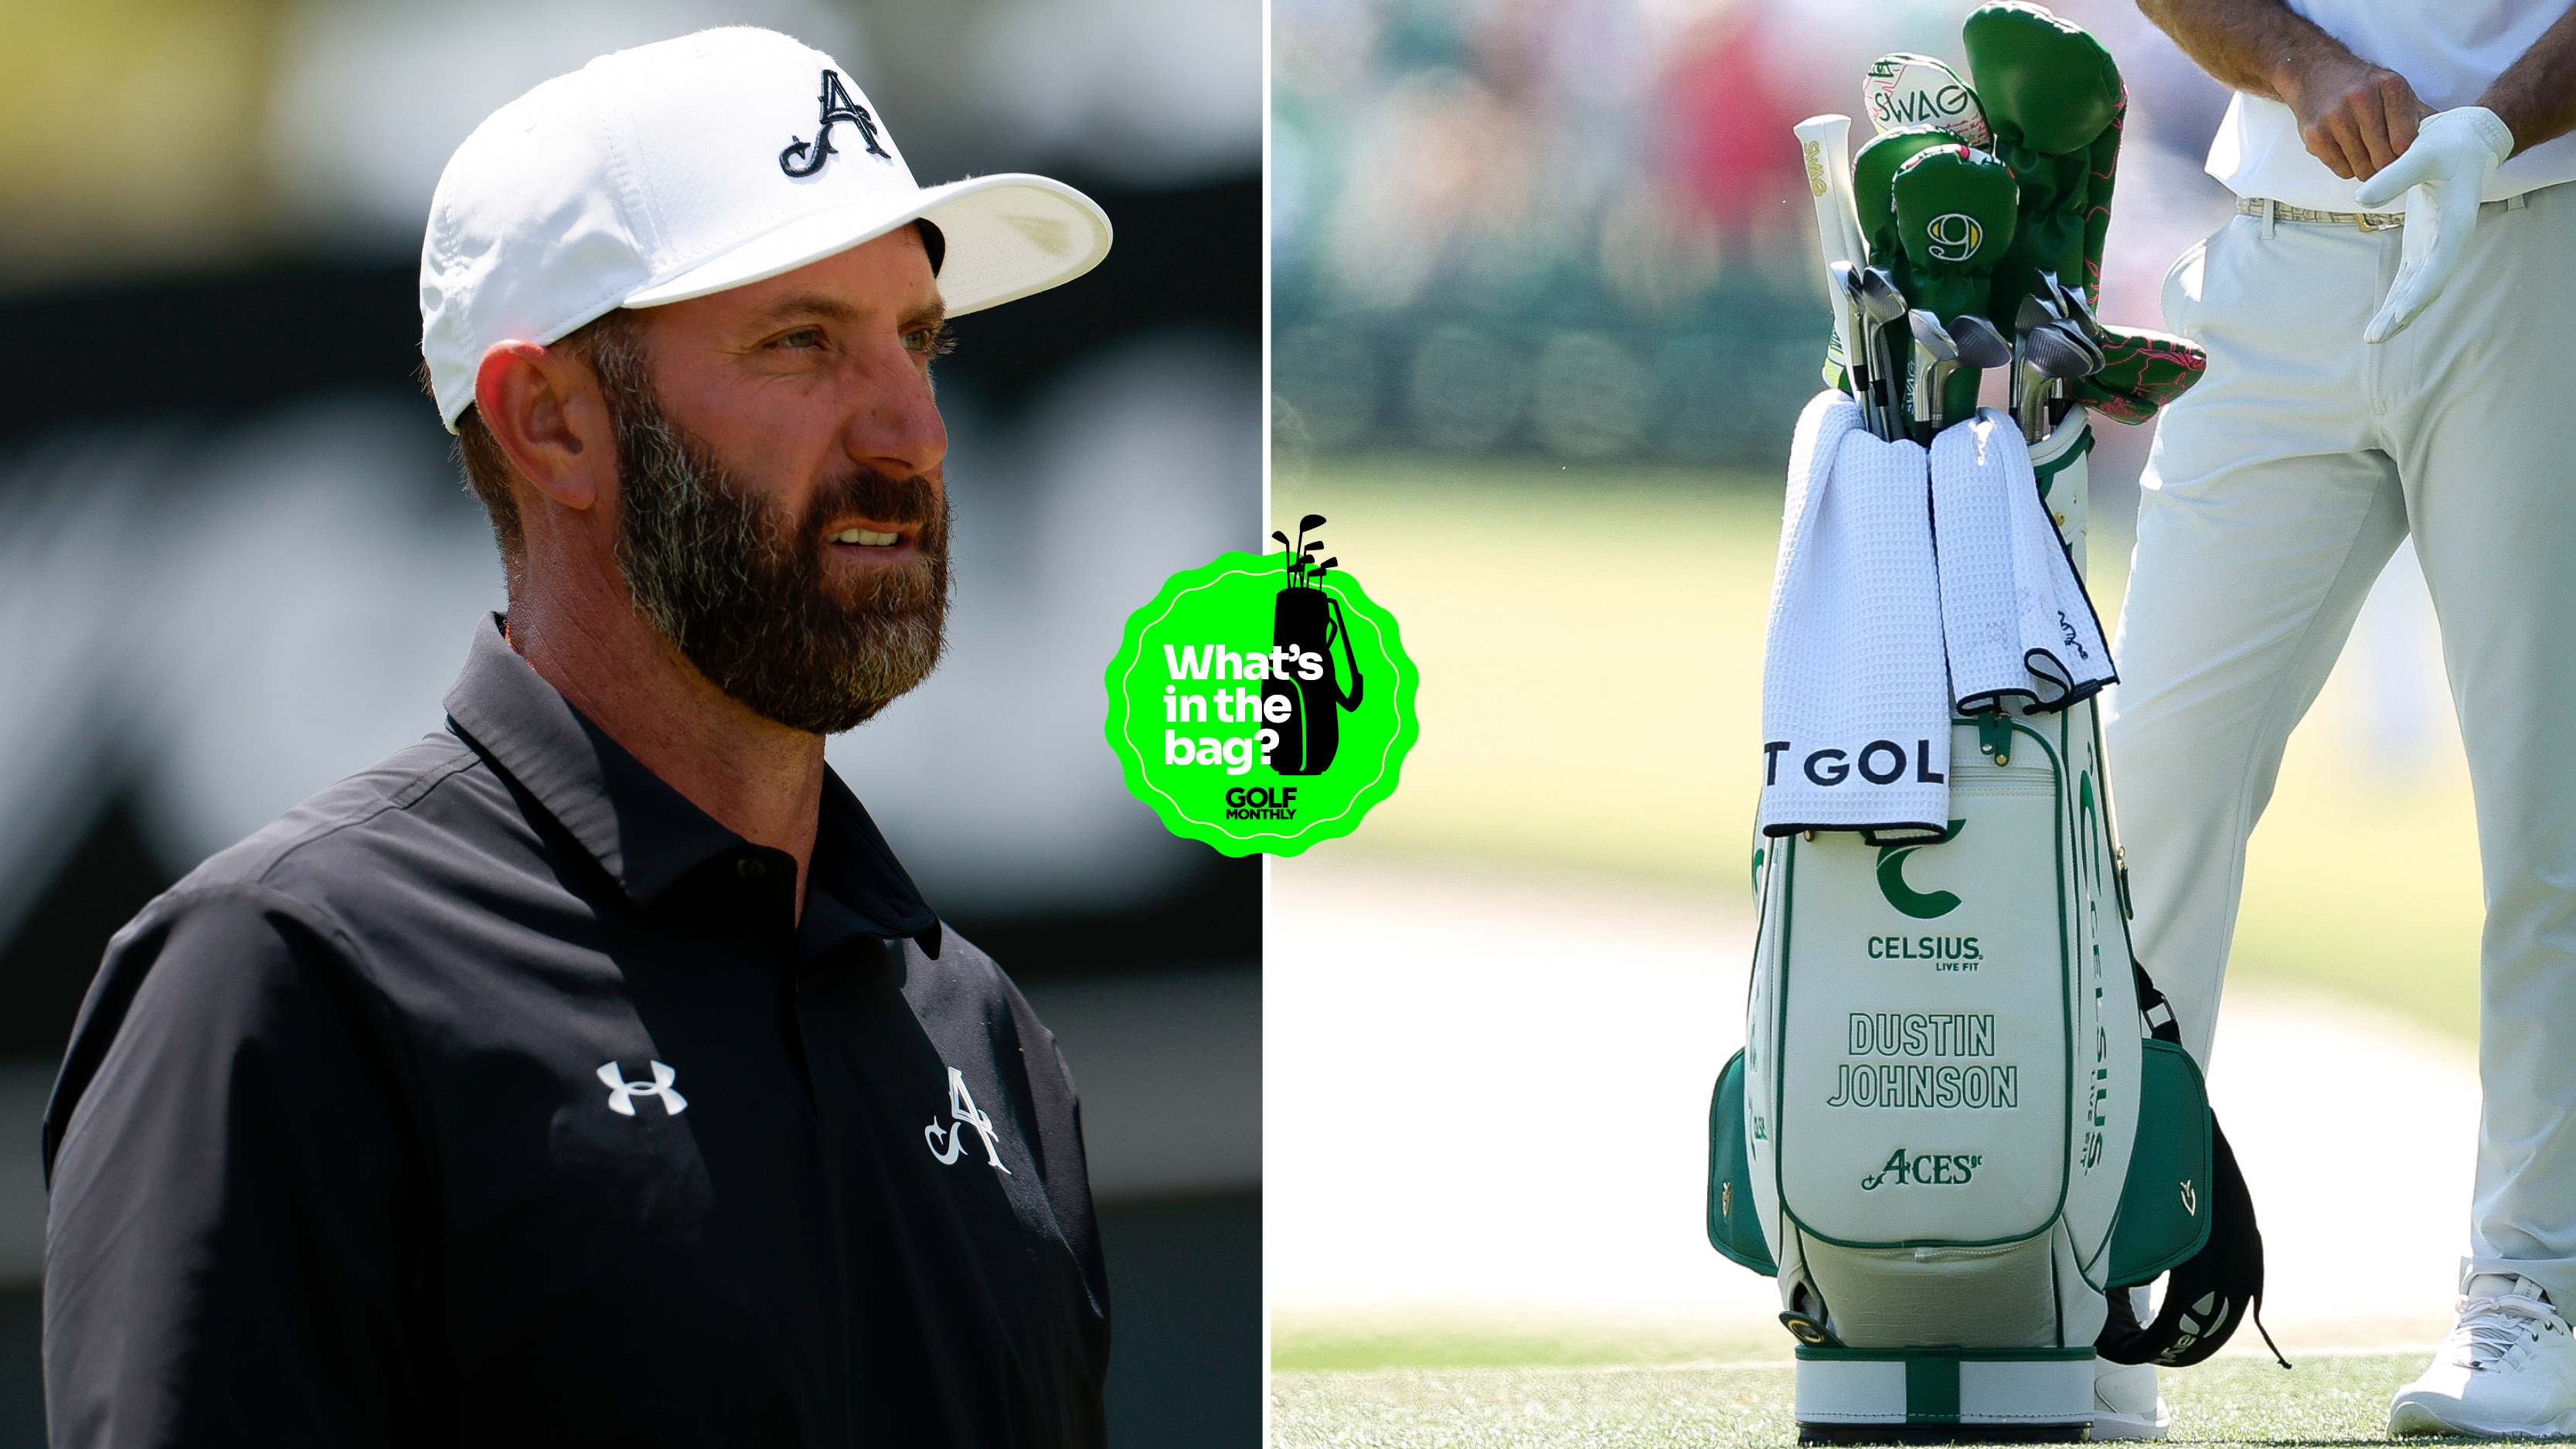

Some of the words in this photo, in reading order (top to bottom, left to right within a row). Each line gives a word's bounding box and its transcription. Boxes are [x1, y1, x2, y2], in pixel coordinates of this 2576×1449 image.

[1874, 85, 1969, 123] SWAG
[1804, 141, 1828, 197] SWAG
[1927, 213, 1983, 262] 9
[1936, 963, 1959, 971] LIVE
[1962, 963, 1979, 971] FIT
[1849, 1013, 1995, 1056] DUSTIN
[1826, 1064, 2018, 1108] JOHNSON
